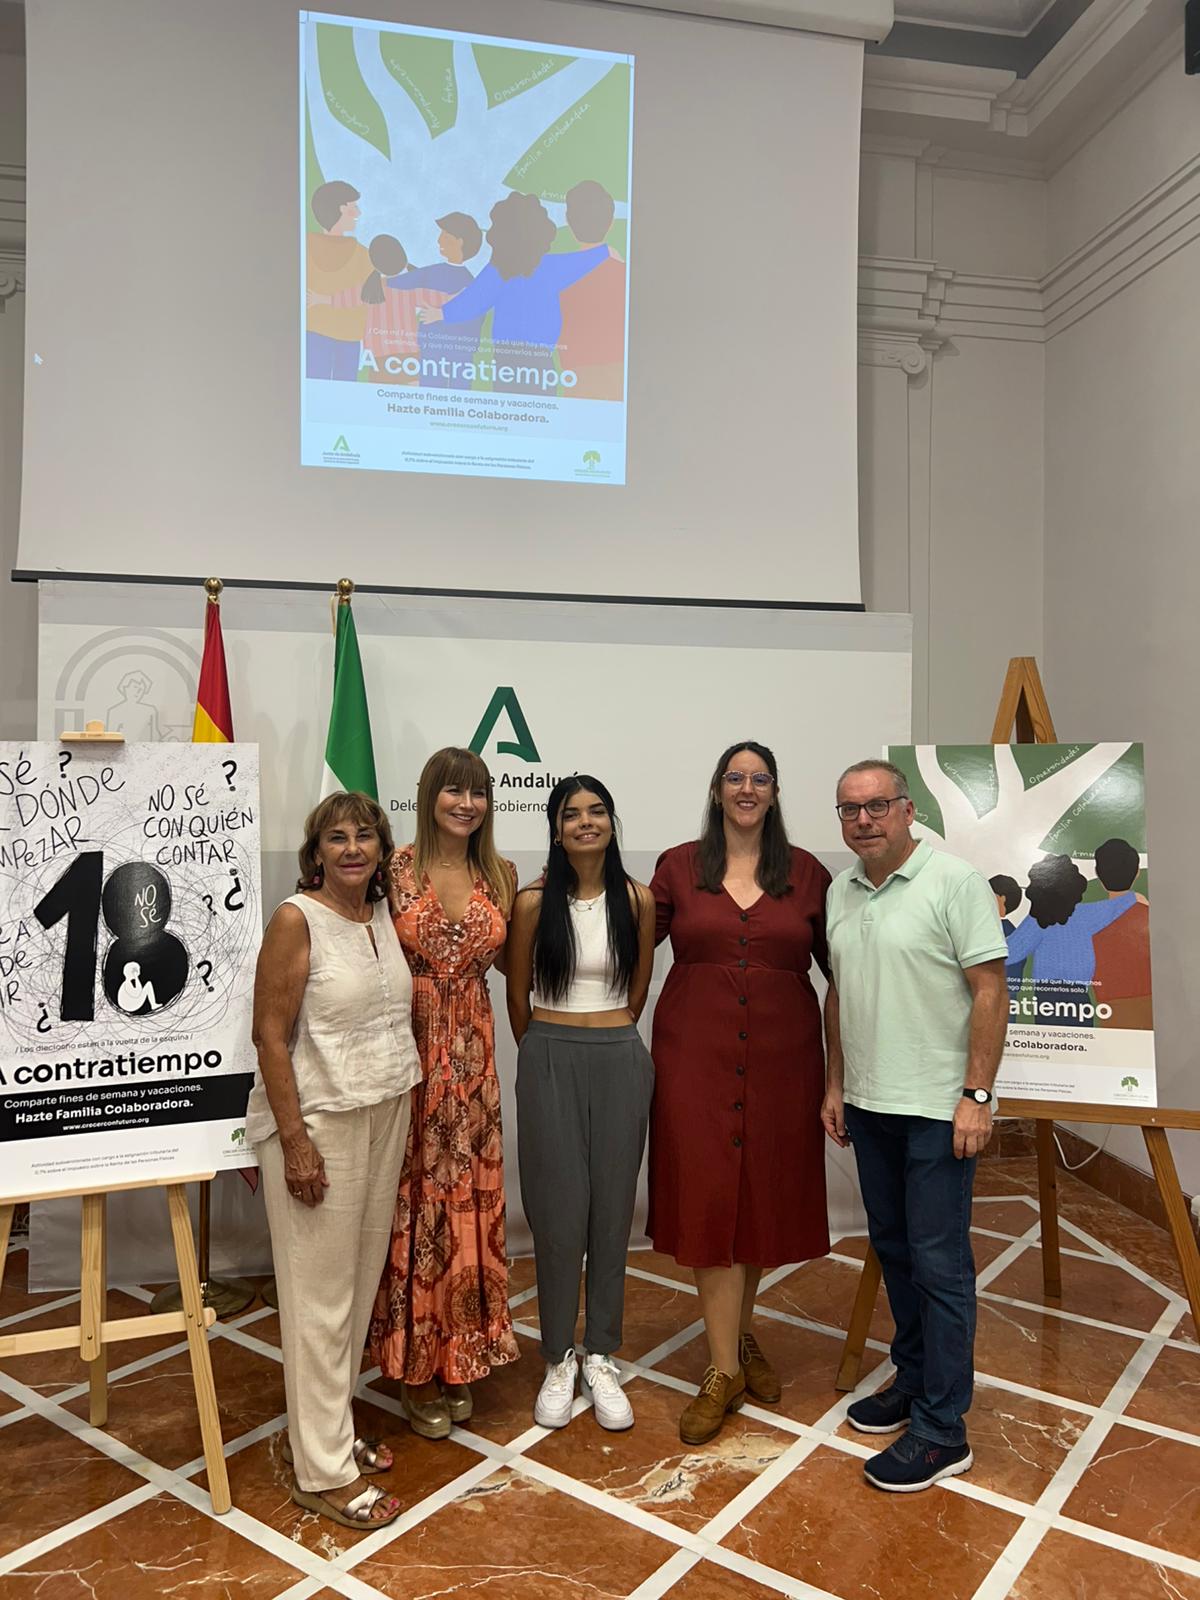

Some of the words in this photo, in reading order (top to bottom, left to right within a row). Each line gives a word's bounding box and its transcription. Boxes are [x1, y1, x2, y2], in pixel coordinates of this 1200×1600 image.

[358, 349, 380, 373] A
[384, 355, 578, 391] contratiempo
[376, 388, 425, 401] Comparte
[426, 392, 449, 402] fines
[450, 394, 462, 403] de
[463, 396, 499, 407] semana
[507, 400, 560, 411] vacaciones.
[387, 402, 421, 415] Hazte
[423, 405, 465, 418] Familia
[467, 408, 550, 424] Colaboradora.
[148, 784, 175, 812] NO
[492, 799, 549, 812] Gobierno
[143, 814, 184, 839] CON
[156, 839, 238, 866] CONTAR
[134, 884, 157, 908] NO
[34, 849, 189, 1022] 18
[1021, 976, 1040, 984] ahora
[1063, 978, 1074, 986] hay
[1075, 979, 1102, 987] muchos
[1009, 996, 1113, 1022] atiempo
[20, 1045, 34, 1053] Los
[115, 1038, 139, 1046] vuelta
[140, 1036, 150, 1044] de
[159, 1033, 189, 1043] esquina
[1009, 1029, 1041, 1037] semana
[1048, 1030, 1096, 1040] vacaciones.
[1012, 1040, 1088, 1052] Colaboradora.
[14, 1050, 222, 1085] contratiempo
[4, 1097, 58, 1109] Comparte
[59, 1094, 84, 1104] fines
[85, 1092, 99, 1101] de
[100, 1089, 139, 1100] semana
[140, 1089, 146, 1098] y
[147, 1084, 204, 1096] vacaciones.
[15, 1110, 53, 1124] Hazte
[56, 1106, 102, 1120] Familia
[104, 1099, 194, 1115] Colaboradora.
